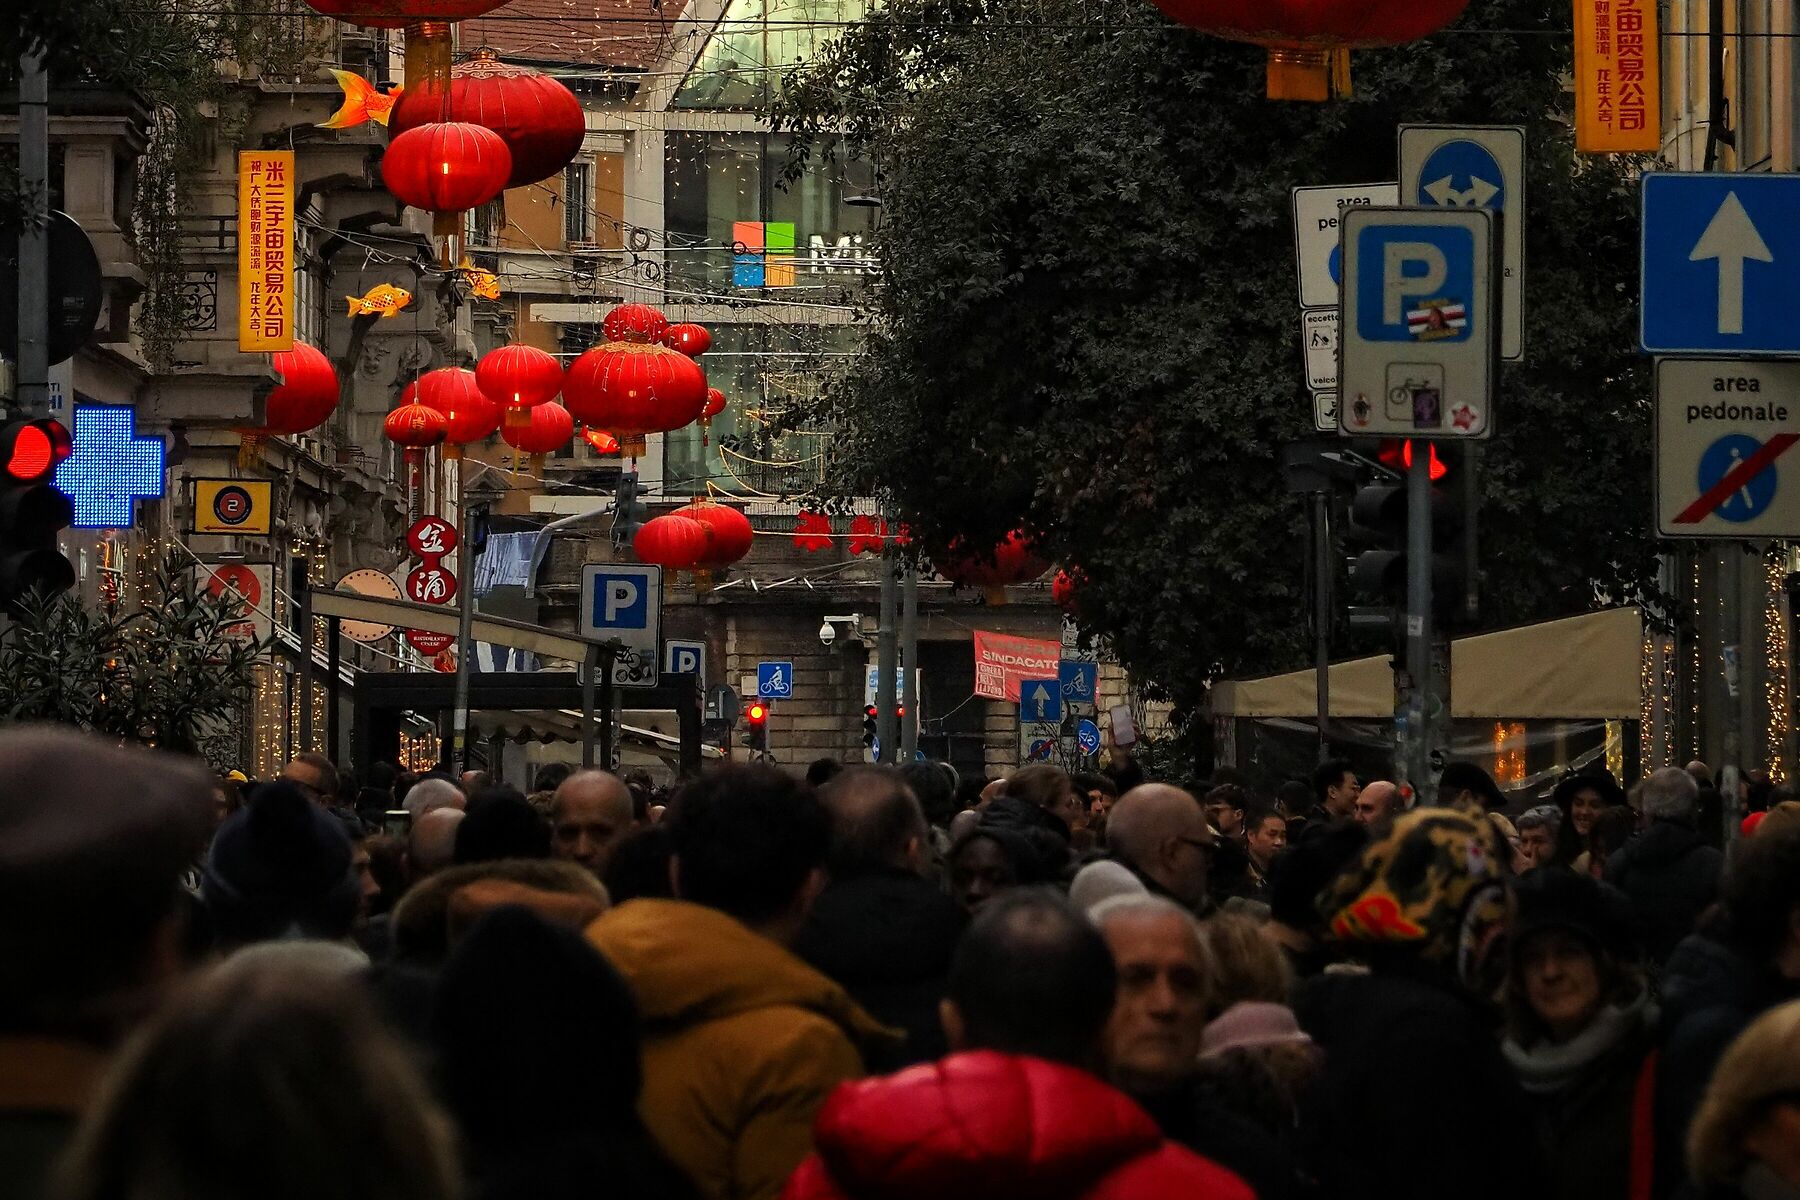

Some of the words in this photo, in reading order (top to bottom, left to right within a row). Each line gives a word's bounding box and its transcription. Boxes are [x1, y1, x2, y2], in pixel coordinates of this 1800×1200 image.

[265, 161, 285, 339] 米兰宇宙贸易公司
[1383, 242, 1448, 326] P
[1713, 376, 1761, 393] area
[1687, 401, 1788, 424] pedonale
[227, 499, 239, 512] 2
[605, 580, 638, 622] P
[678, 650, 696, 673] P
